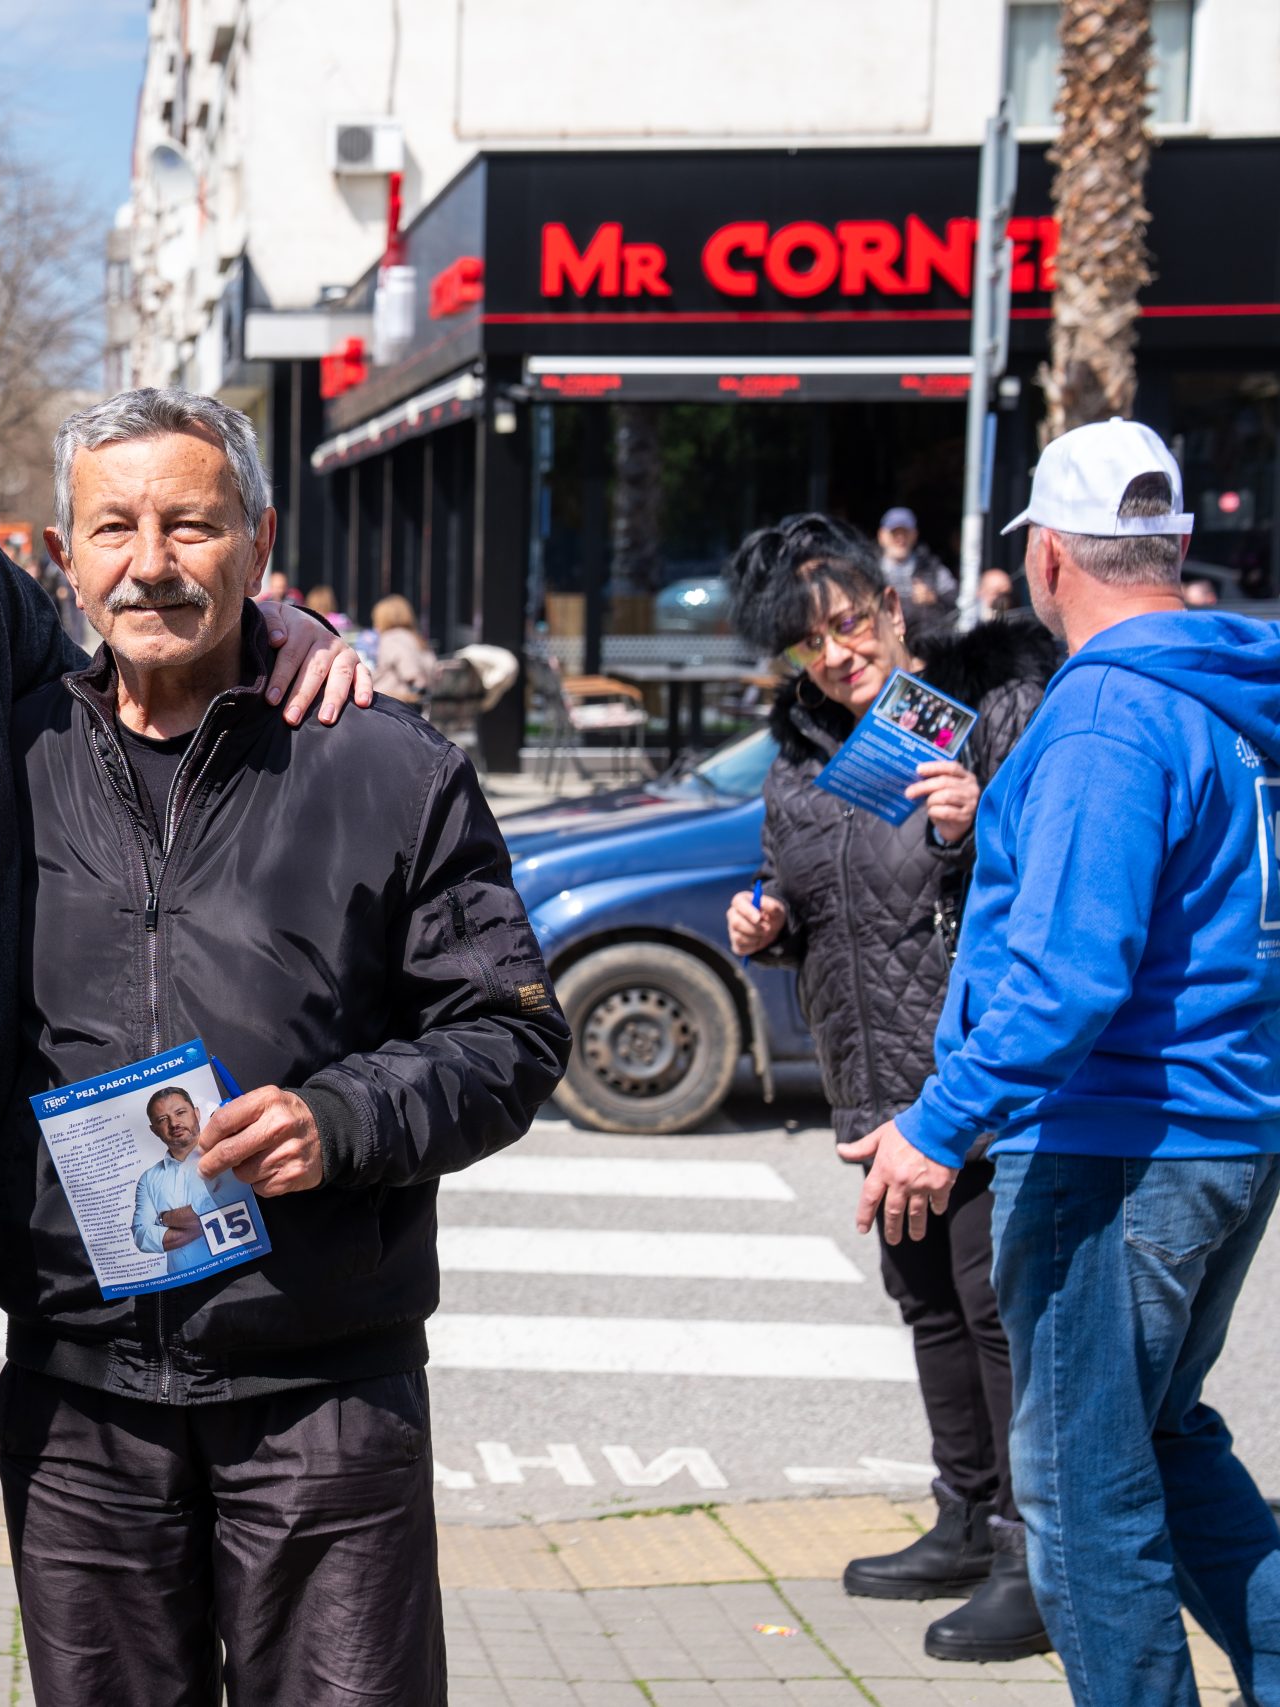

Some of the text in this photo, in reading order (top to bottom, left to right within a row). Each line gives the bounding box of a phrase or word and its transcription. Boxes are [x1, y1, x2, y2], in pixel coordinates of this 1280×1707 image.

[76, 1088, 98, 1099] РЕД,
[100, 1073, 142, 1091] РАБОТА,
[143, 1056, 184, 1077] РАСТЕЖ
[205, 1209, 251, 1245] 15
